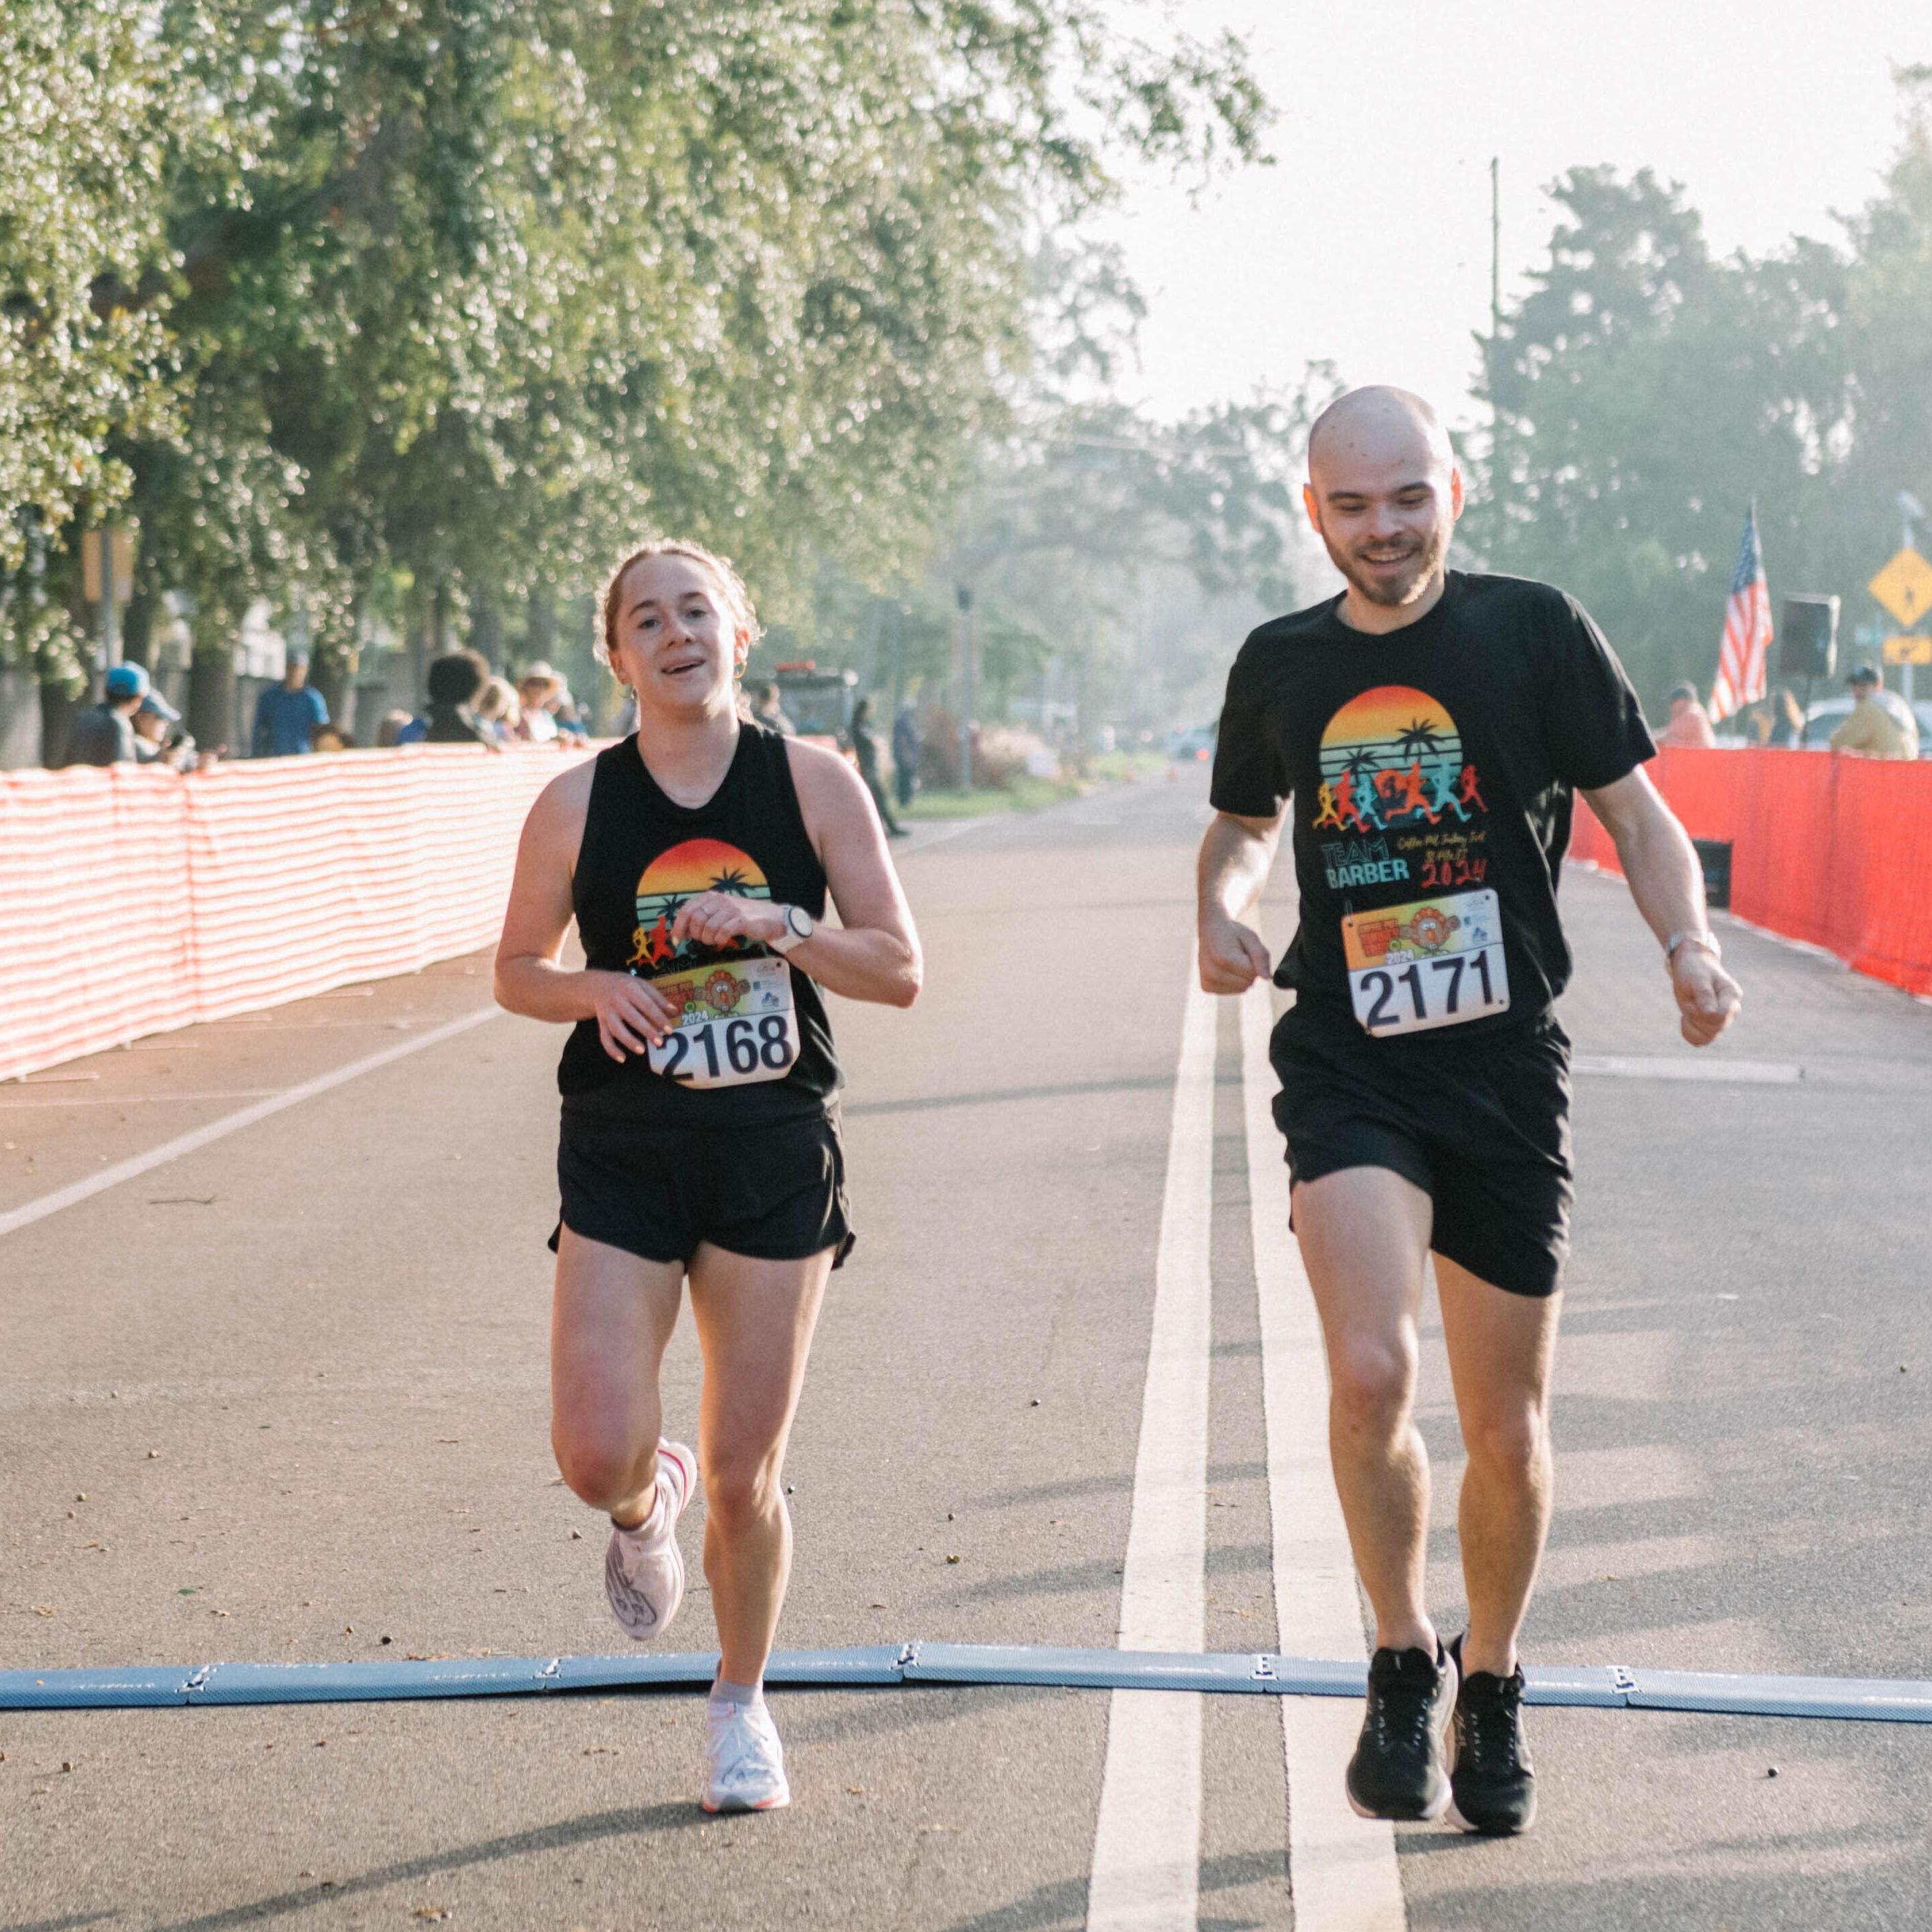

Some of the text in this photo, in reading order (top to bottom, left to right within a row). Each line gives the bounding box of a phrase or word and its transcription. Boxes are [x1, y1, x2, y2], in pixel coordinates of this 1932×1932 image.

[1320, 838, 1390, 868] TEAM
[1326, 858, 1410, 889] BARBER
[1421, 859, 1487, 888] 2024
[1360, 950, 1493, 1027] 2171
[681, 1010, 708, 1027] 2024
[656, 1015, 793, 1081] 2168
